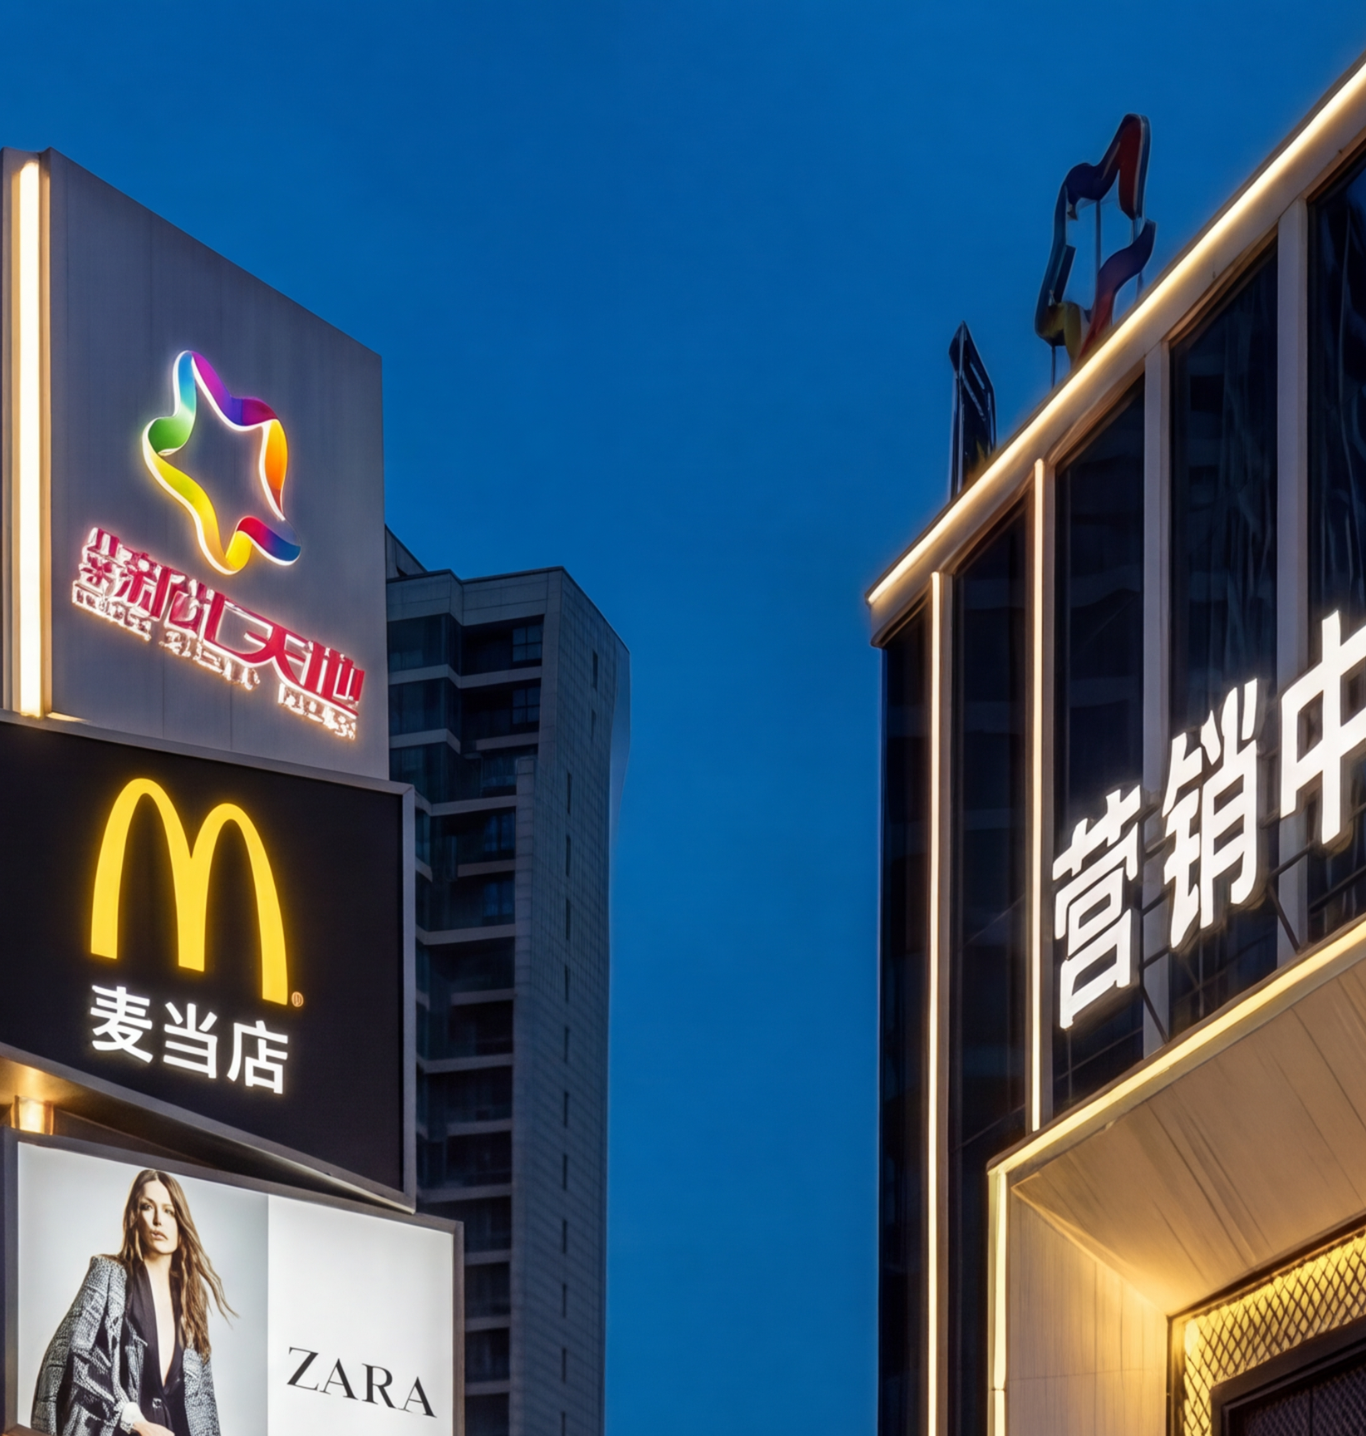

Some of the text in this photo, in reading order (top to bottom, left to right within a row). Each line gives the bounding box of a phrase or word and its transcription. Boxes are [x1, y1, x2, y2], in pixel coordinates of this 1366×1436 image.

[89, 984, 290, 1095] 麦当店
[285, 1346, 438, 1419] ZARA
